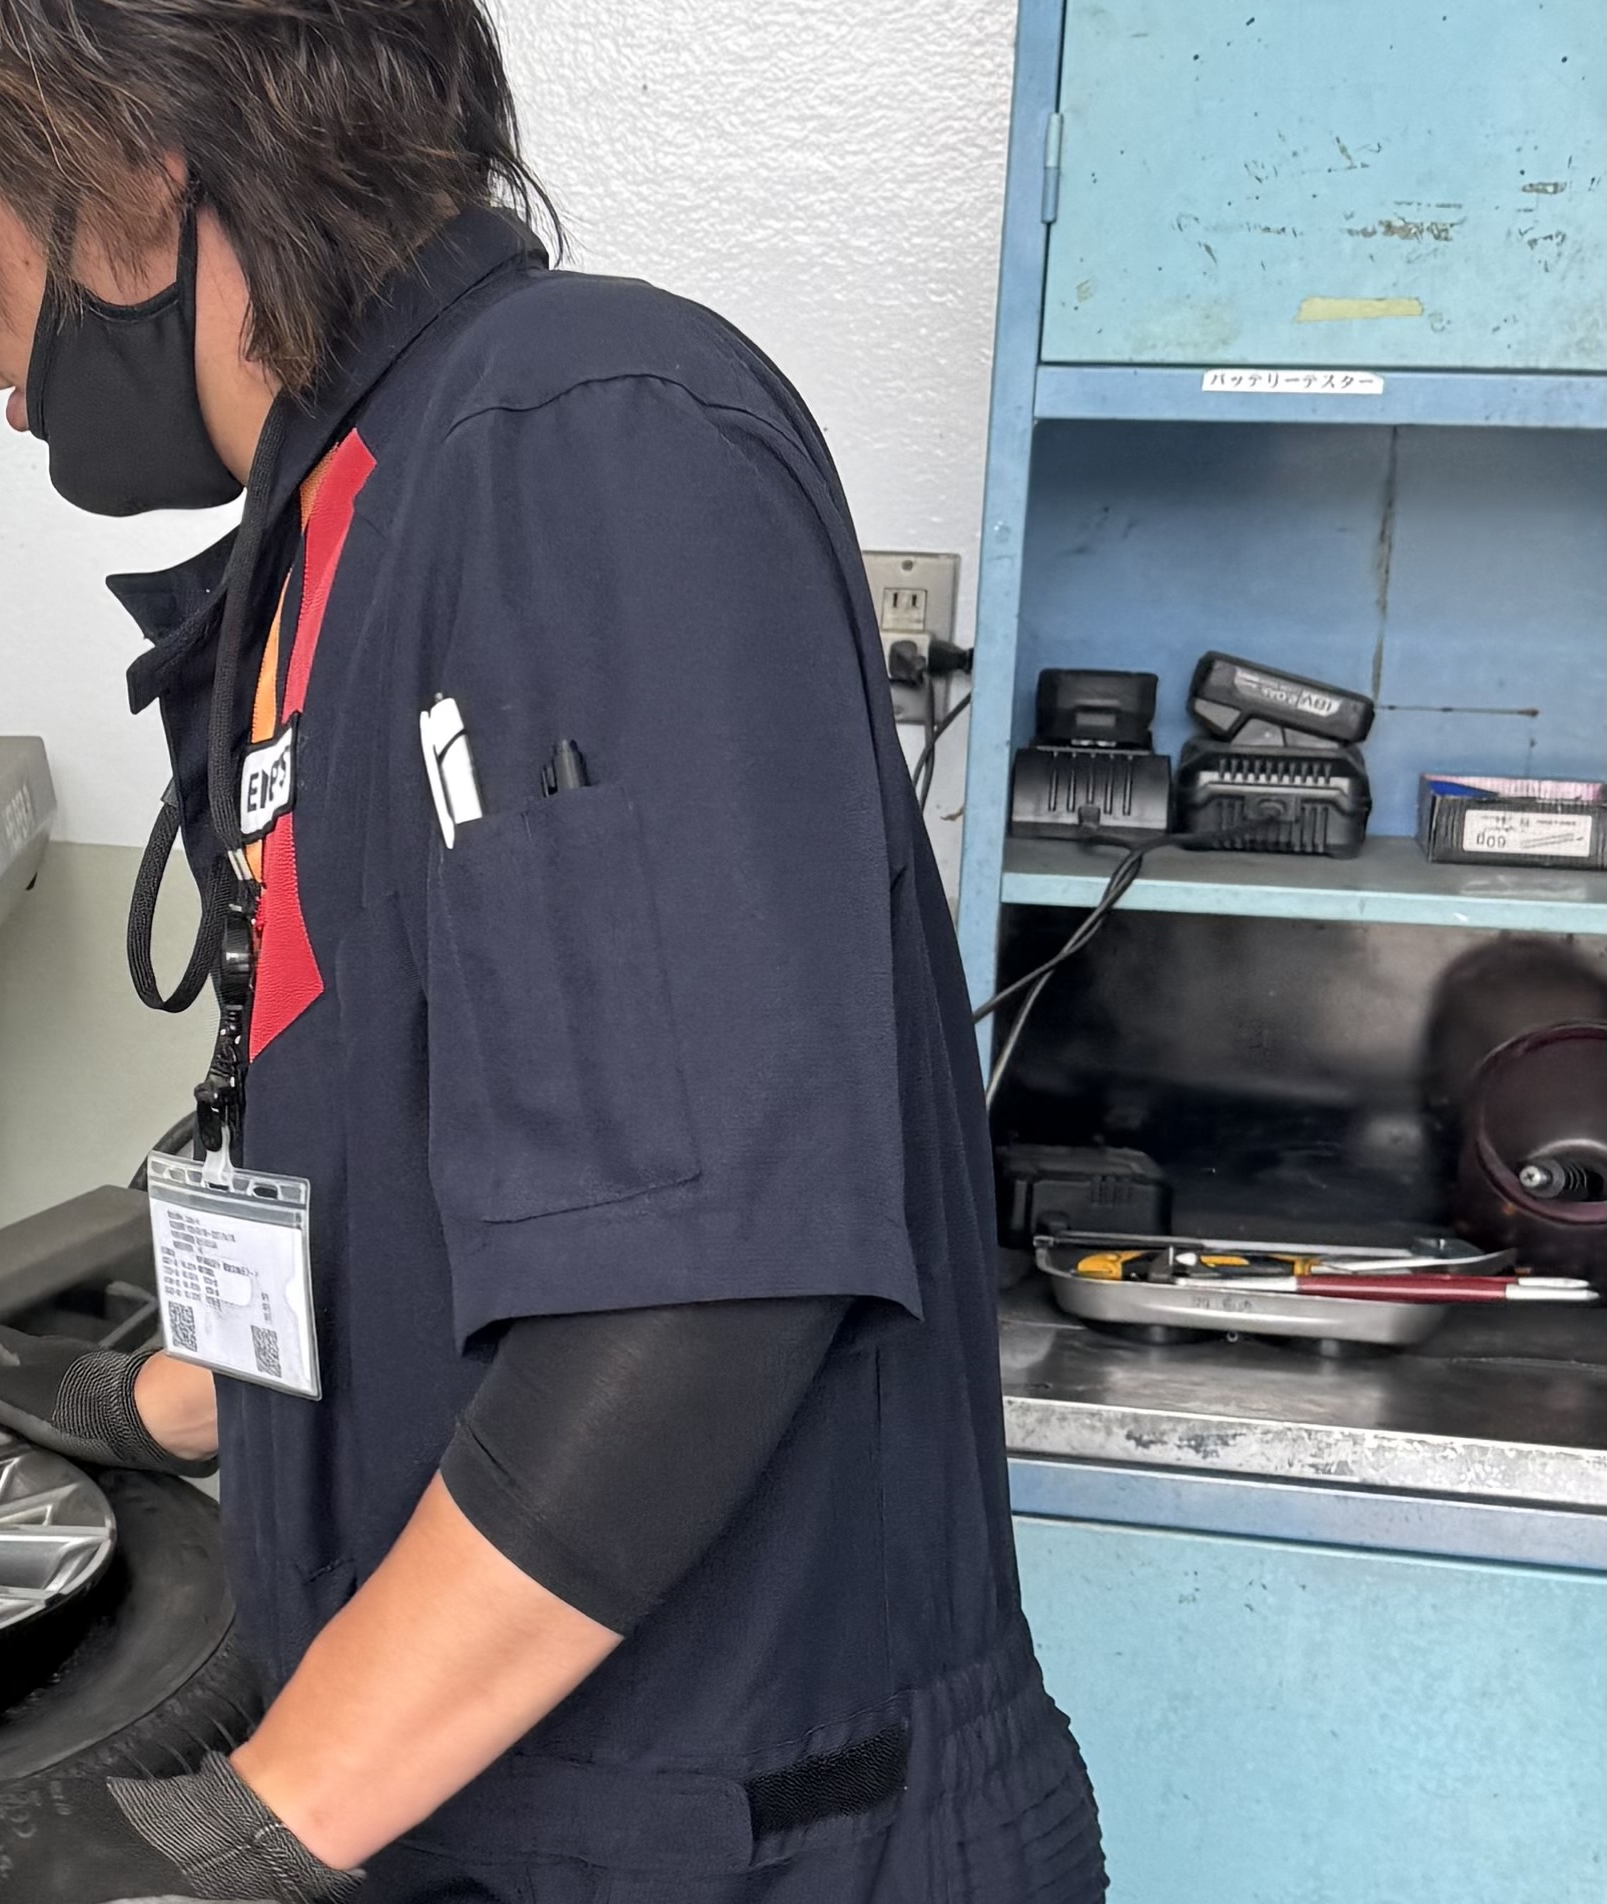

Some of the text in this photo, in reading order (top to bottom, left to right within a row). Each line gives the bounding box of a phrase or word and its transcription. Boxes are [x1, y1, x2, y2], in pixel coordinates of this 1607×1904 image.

[1210, 372, 1374, 389] バッテリーテスター
